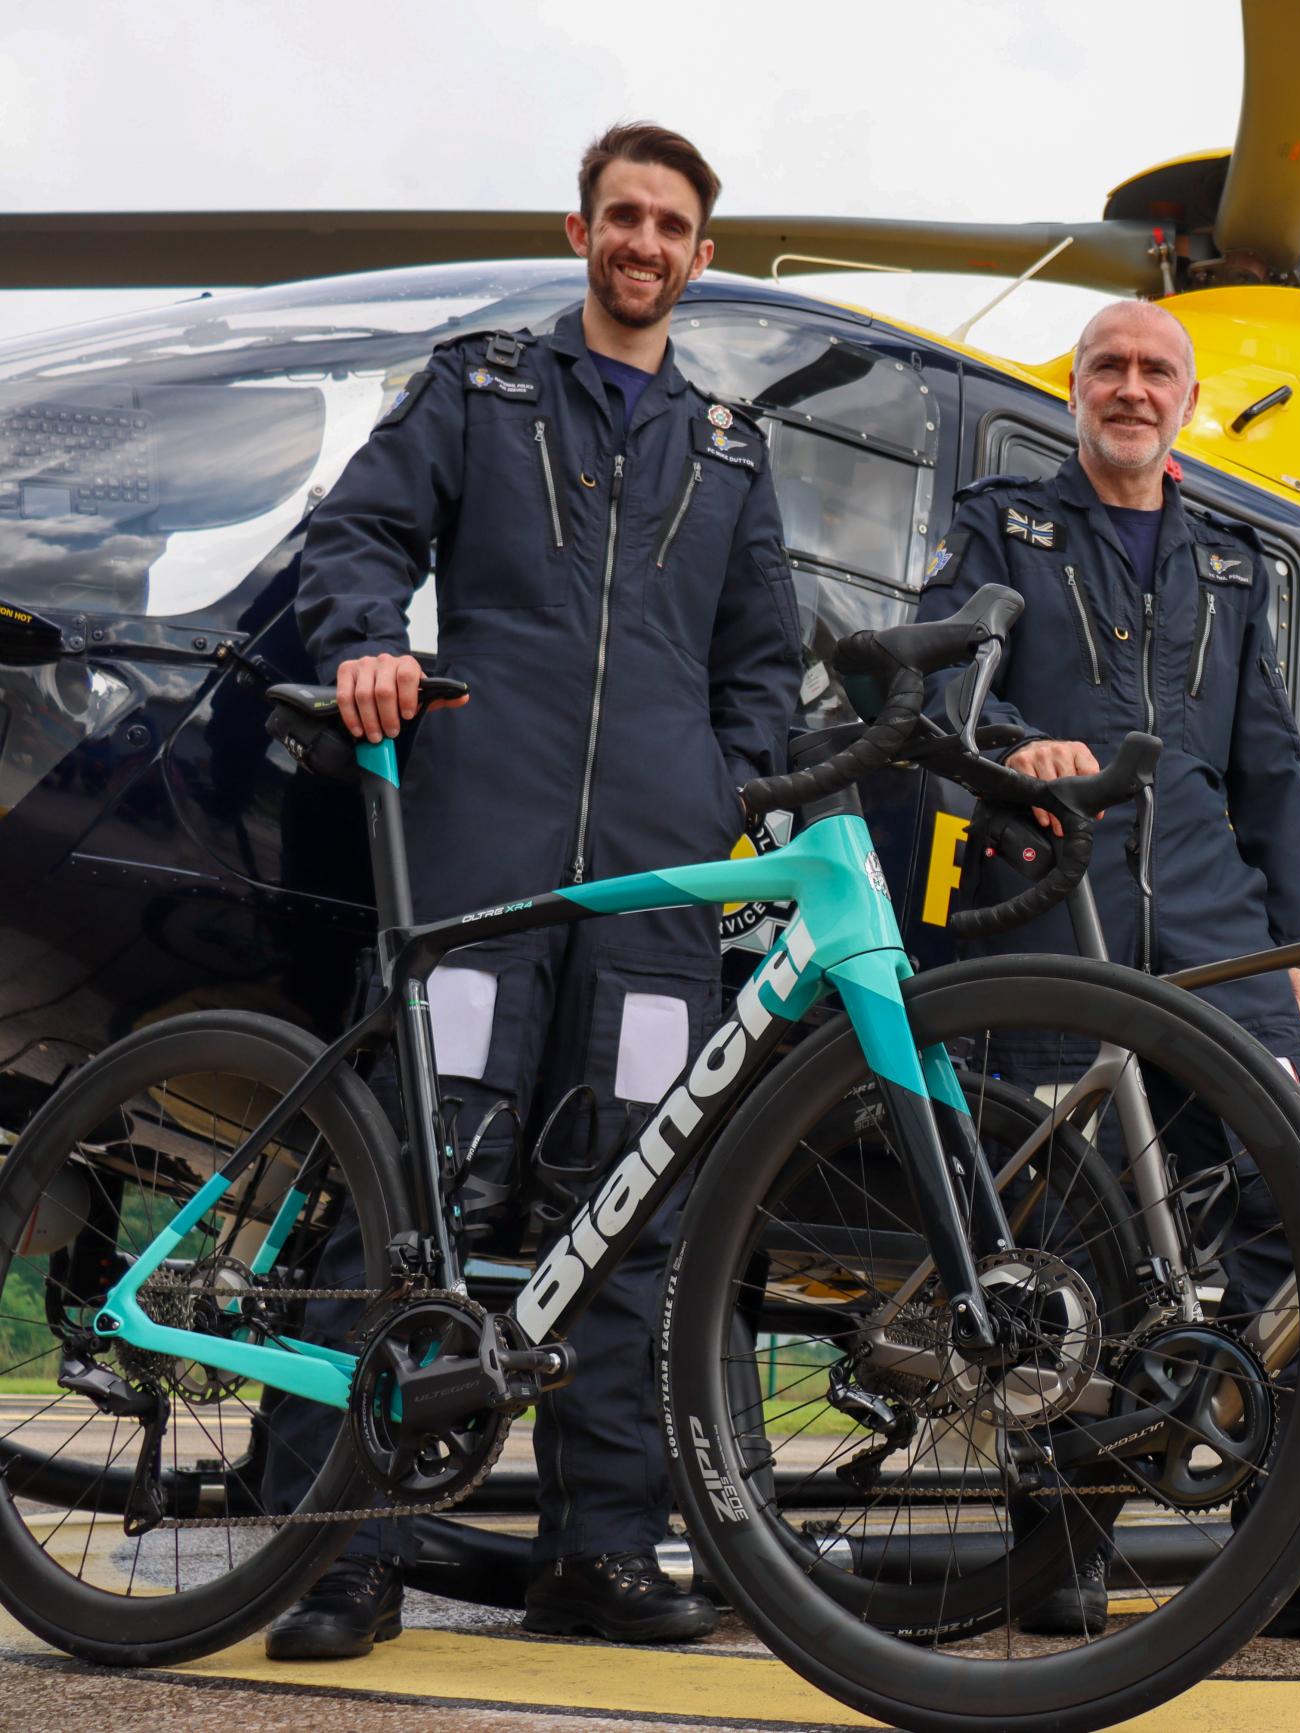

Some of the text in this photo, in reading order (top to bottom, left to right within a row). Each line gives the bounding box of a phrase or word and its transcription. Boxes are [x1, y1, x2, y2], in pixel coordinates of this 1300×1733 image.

[0, 606, 33, 624] ON HOT
[462, 900, 533, 924] OLTRE XR4
[661, 1298, 673, 1352] EAGLE
[414, 1380, 480, 1402] ULTEGRA
[661, 1360, 679, 1459] GOODYEAR
[1097, 1420, 1165, 1457] ULTEGRA
[689, 1415, 724, 1523] ZIPP
[915, 1622, 961, 1637] ZERO
